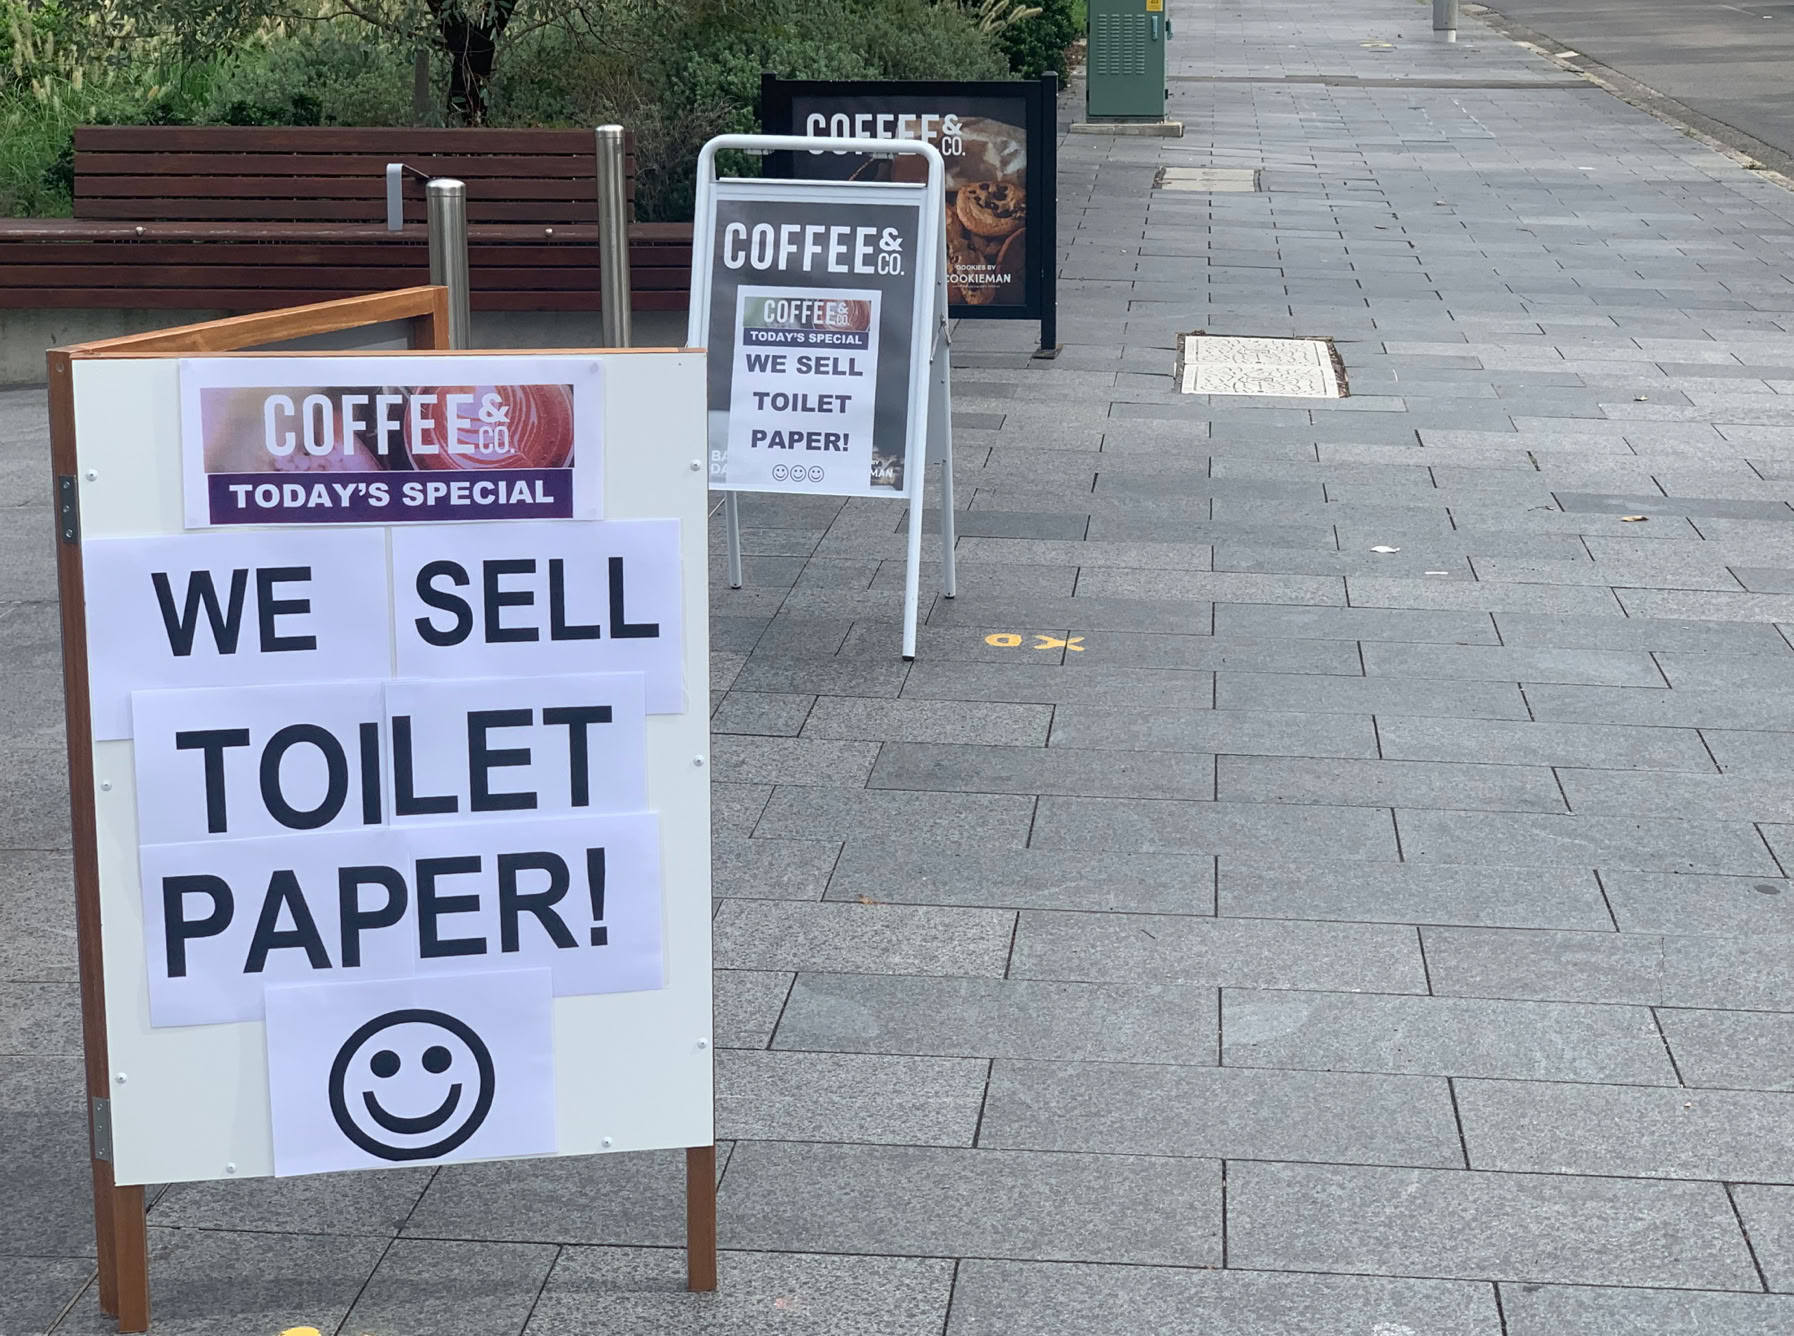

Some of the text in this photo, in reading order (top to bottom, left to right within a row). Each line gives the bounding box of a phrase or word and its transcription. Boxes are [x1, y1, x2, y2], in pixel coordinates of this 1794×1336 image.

[750, 331, 863, 345] TODAY’S SPECIAL
[746, 354, 863, 377] WE SELL
[752, 391, 852, 413] TOILET
[751, 429, 850, 452] PAPER!
[229, 480, 555, 509] TODAY’S SPECIAL
[151, 556, 660, 657] WE SELL
[175, 705, 613, 834] TOILET
[162, 847, 608, 978] PAPER!
